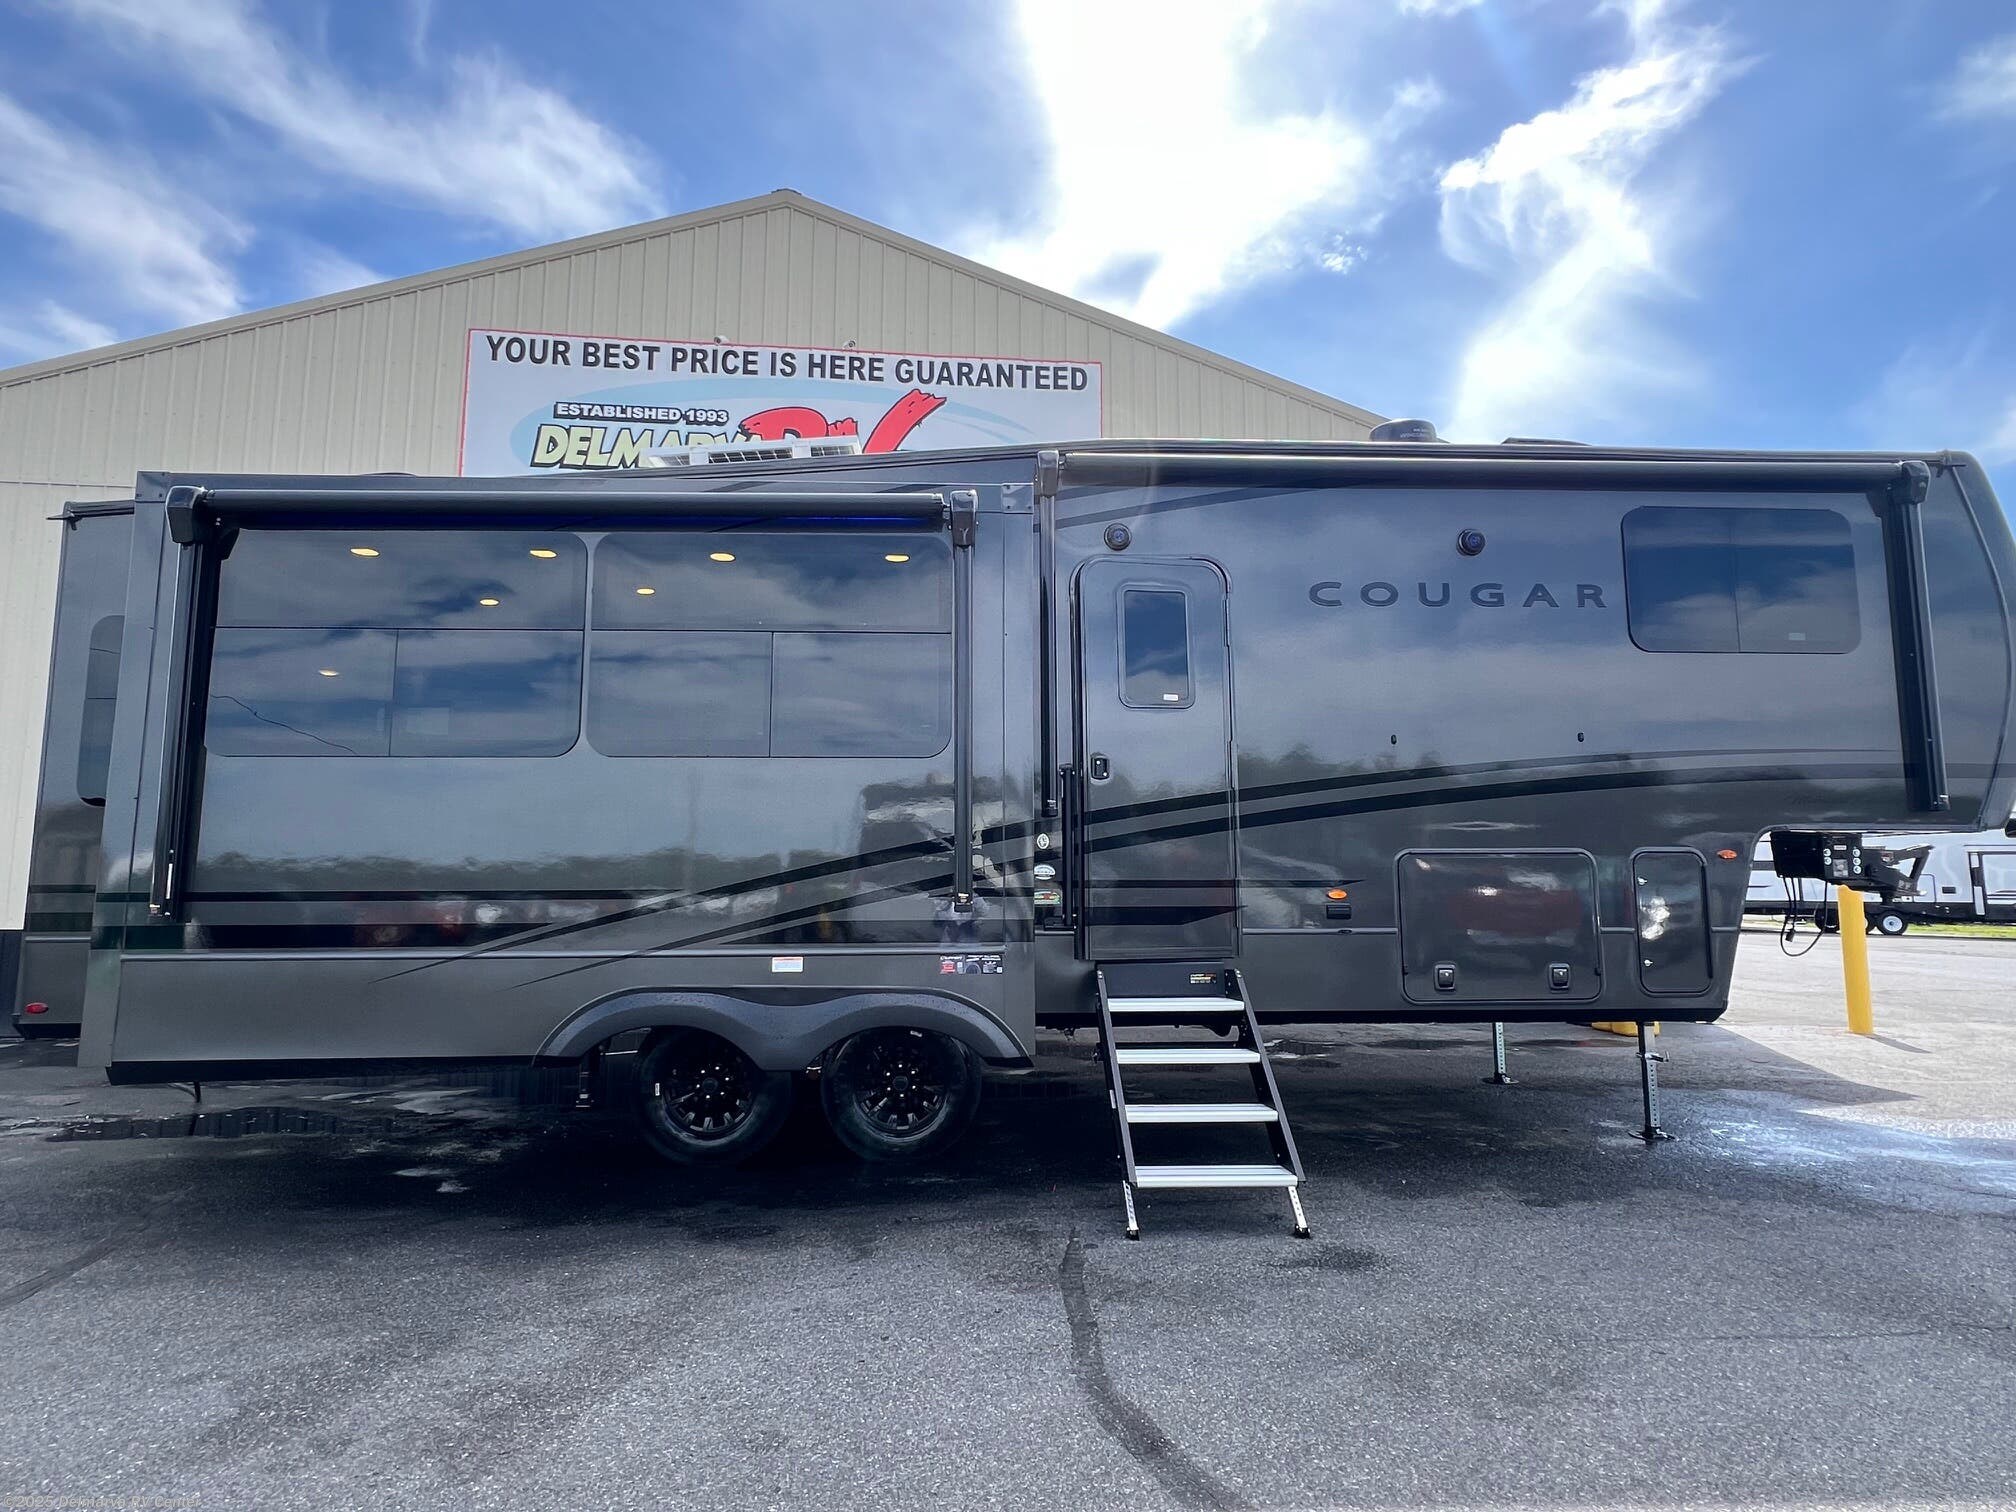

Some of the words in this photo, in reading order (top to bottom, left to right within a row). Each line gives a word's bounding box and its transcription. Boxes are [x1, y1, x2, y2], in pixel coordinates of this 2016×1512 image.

[486, 335, 571, 366] YOUR
[582, 341, 661, 371] BEST
[671, 346, 759, 375] PRICE
[770, 351, 797, 377] IS
[808, 353, 884, 382] HERE
[895, 358, 1088, 391] GUARANTEED
[555, 402, 682, 422] ESTABLISHED
[686, 408, 729, 423] 1993
[531, 424, 764, 469] DELM
[1309, 581, 1607, 608] COUGAR
